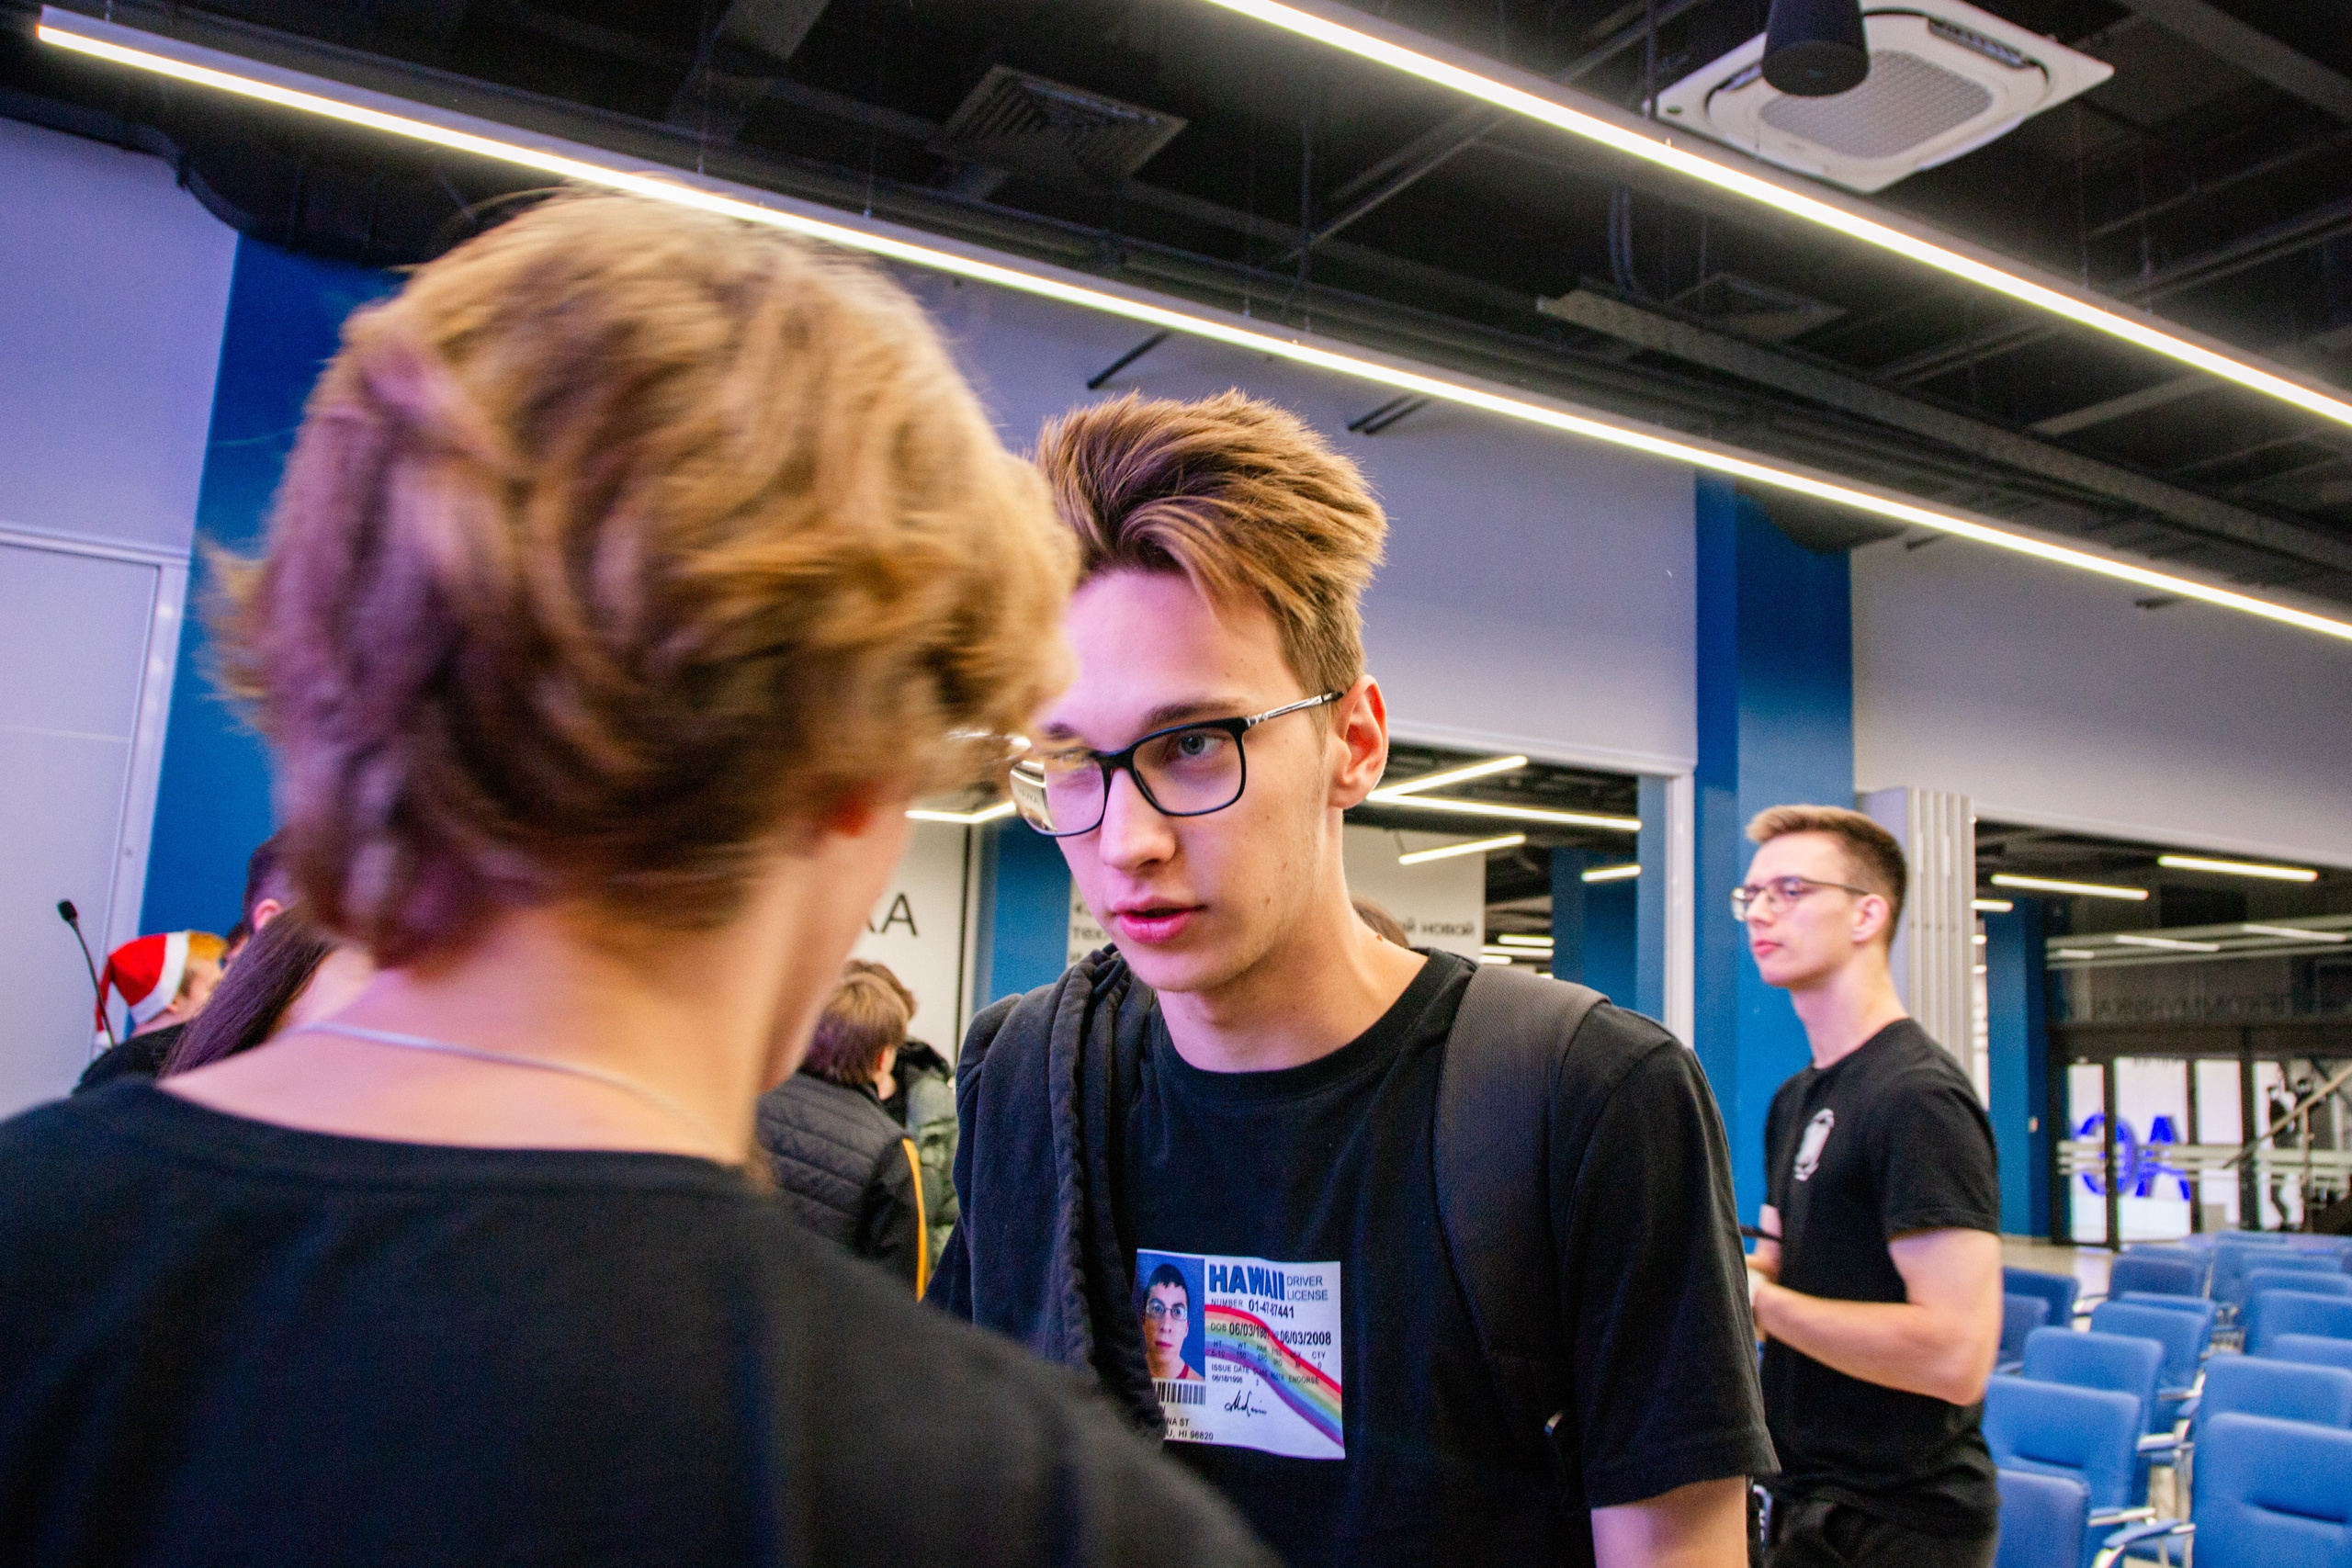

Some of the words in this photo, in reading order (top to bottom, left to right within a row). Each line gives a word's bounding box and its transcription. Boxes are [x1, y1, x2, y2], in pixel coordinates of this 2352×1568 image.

[1209, 1264, 1285, 1301] HAWAII
[1286, 1275, 1323, 1287] DRIVER
[1287, 1290, 1329, 1301] LICENSE
[1211, 1298, 1244, 1307] NUMBER
[1210, 1322, 1227, 1332] DOB
[1280, 1329, 1332, 1347] 06/03/2008
[1312, 1350, 1326, 1360] CTY
[1211, 1363, 1232, 1372] ISSUE
[1233, 1364, 1250, 1374] DATE
[1180, 1417, 1190, 1427] ST
[1178, 1430, 1187, 1438] HI
[1190, 1430, 1214, 1441] 96820
